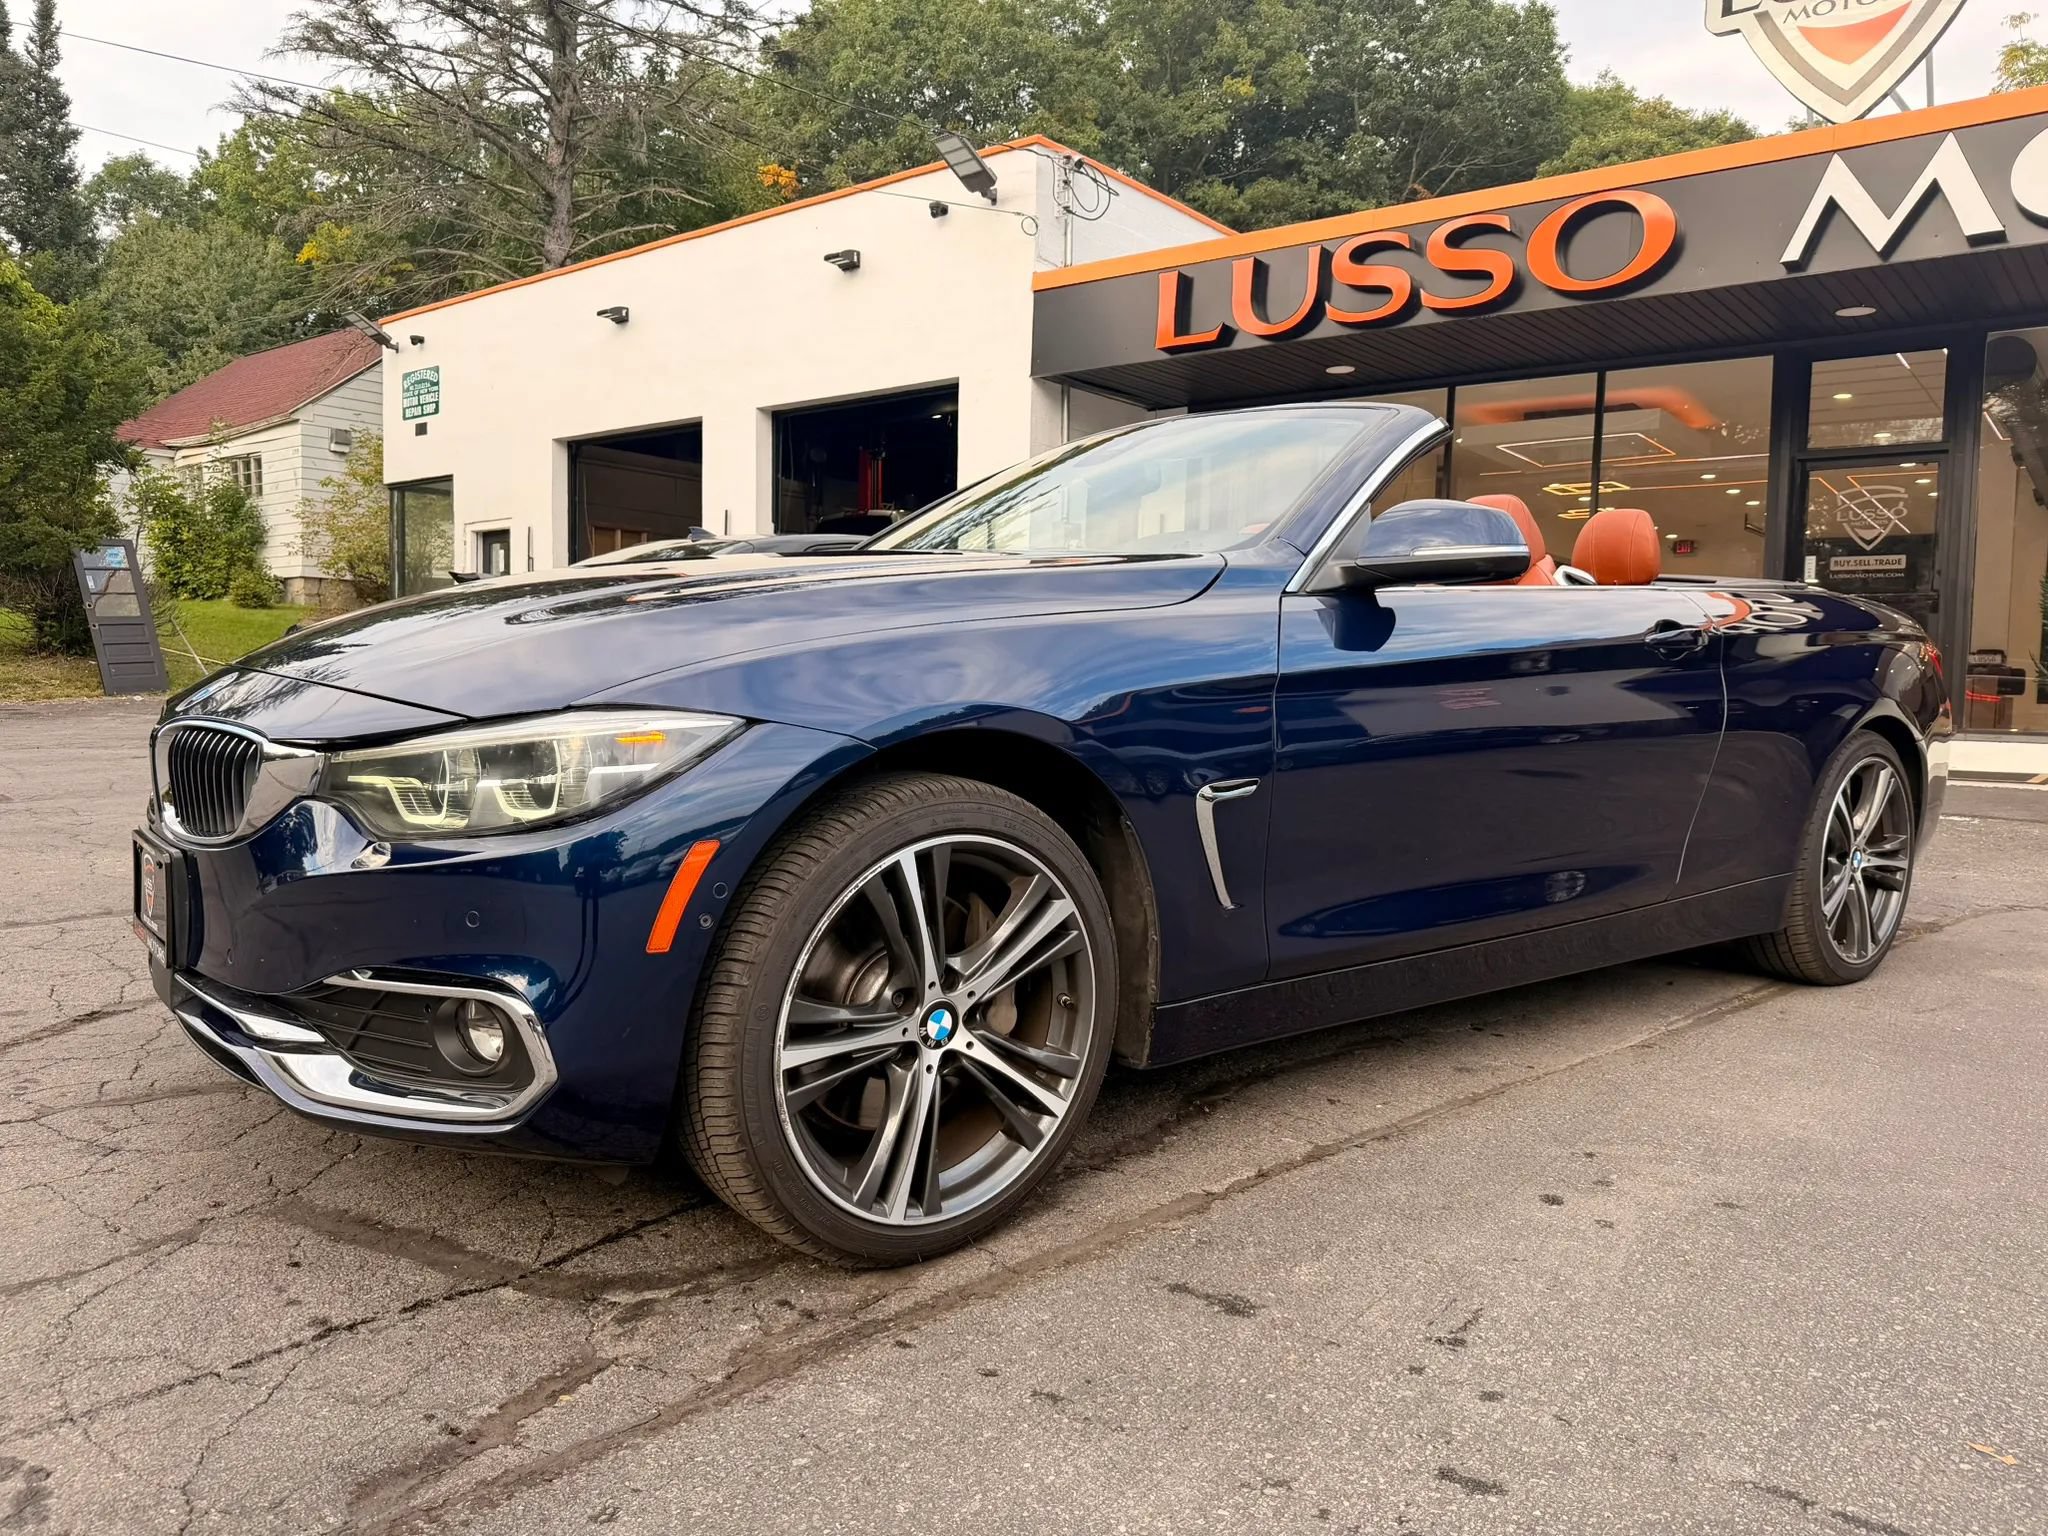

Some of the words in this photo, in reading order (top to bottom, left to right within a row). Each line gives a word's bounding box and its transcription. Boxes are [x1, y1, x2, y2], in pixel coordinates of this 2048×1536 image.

[1155, 189, 1678, 350] LUSSO
[419, 391, 439, 404] VEHICLE
[405, 406, 422, 418] REPAIR
[422, 403, 436, 414] SHOP
[1836, 506, 1908, 521] LUSSO
[919, 1026, 949, 1048] BMW
